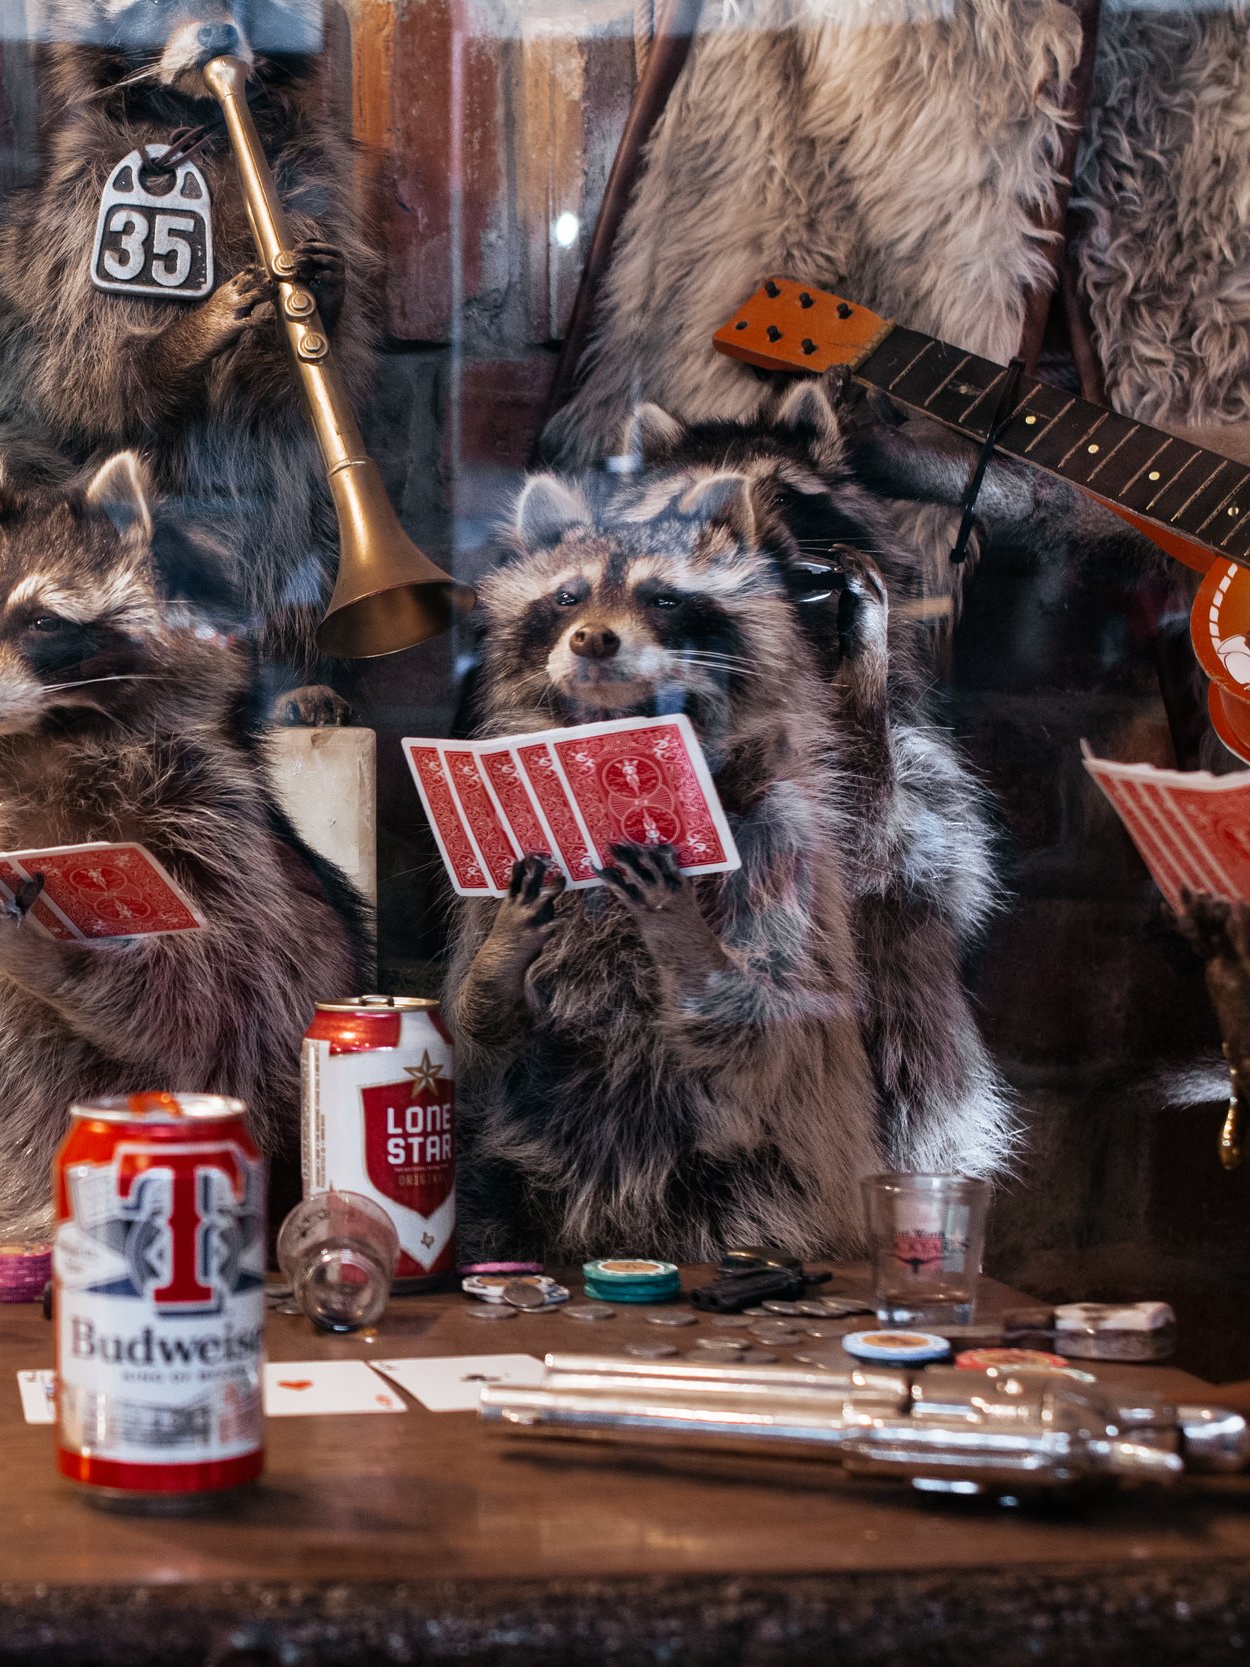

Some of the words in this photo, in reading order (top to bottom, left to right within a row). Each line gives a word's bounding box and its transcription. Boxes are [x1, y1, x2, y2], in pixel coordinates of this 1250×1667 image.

[103, 209, 196, 287] 35
[386, 1103, 452, 1135] LONE
[386, 1134, 452, 1165] STAR
[397, 1173, 447, 1187] ORIGINA
